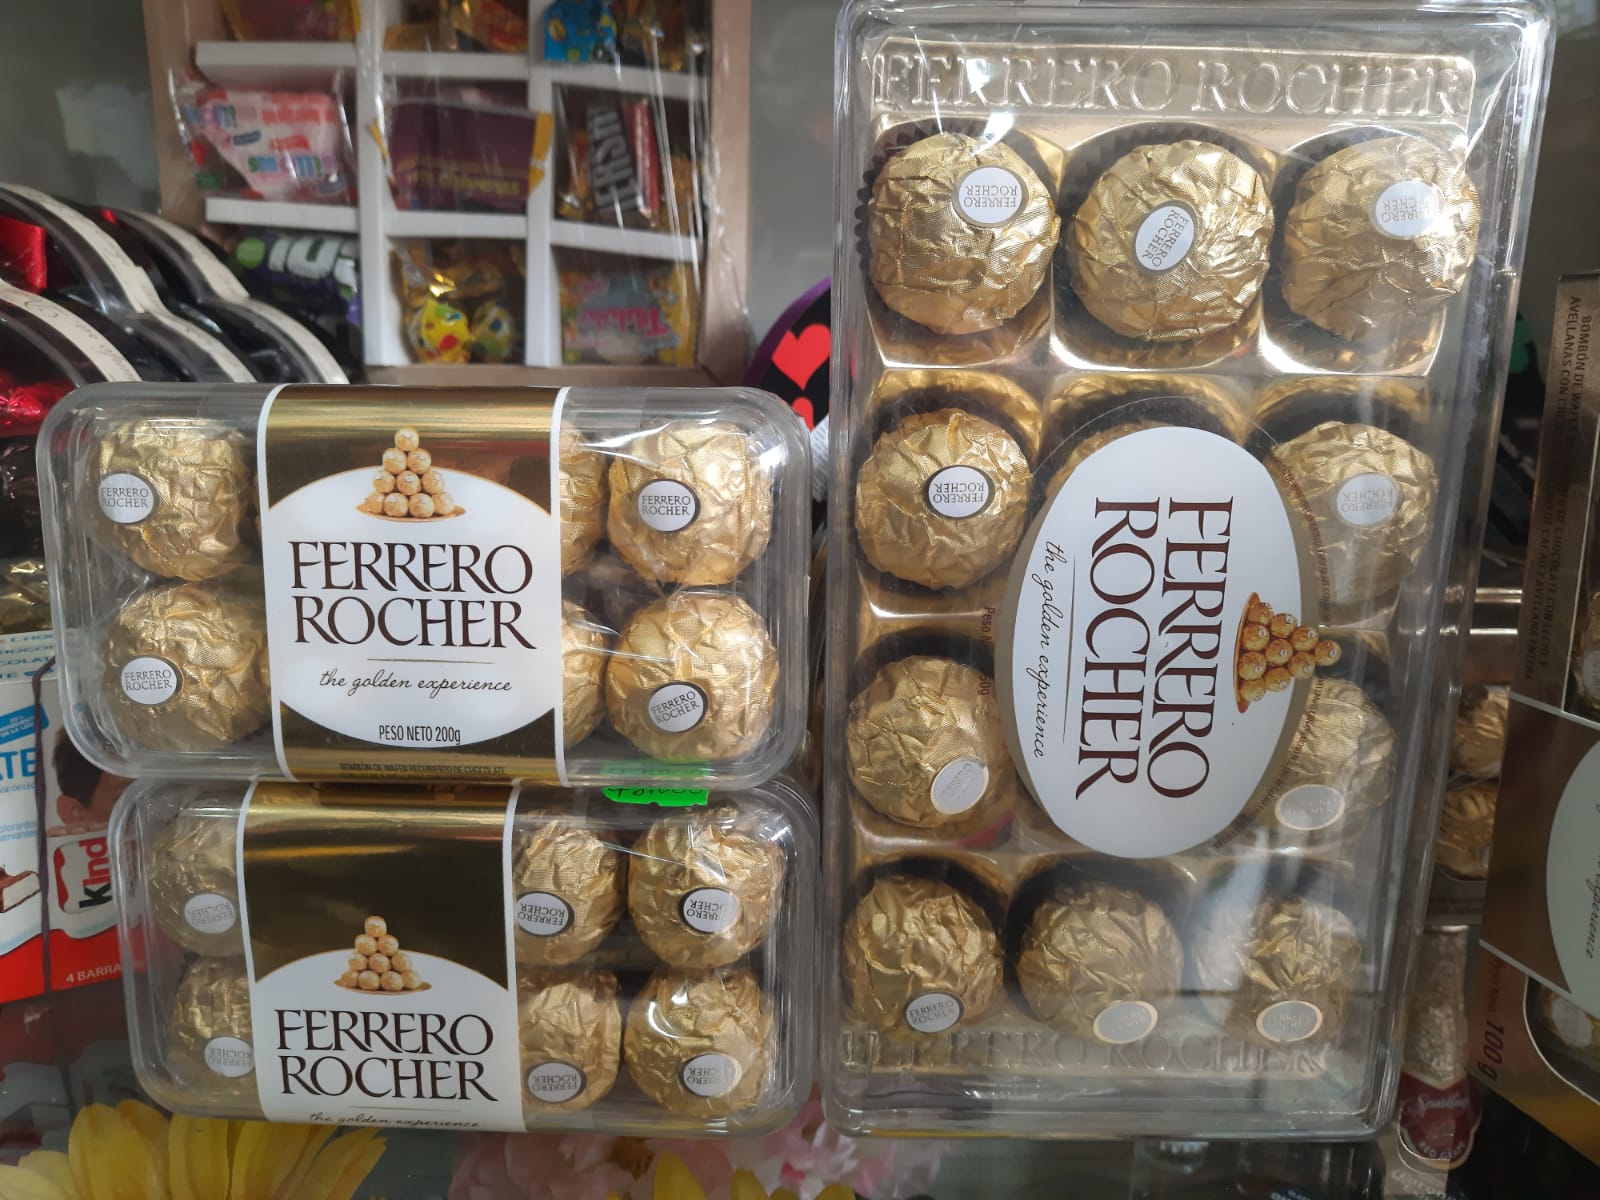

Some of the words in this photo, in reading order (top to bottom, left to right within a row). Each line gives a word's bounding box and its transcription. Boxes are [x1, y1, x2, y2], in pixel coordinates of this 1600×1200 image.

[1191, 59, 1461, 117] ROCHER
[963, 196, 1017, 208] FERRERO
[965, 184, 1017, 197] ROCHER
[1141, 209, 1180, 259] ROCHER
[1151, 215, 1189, 267] FERRERO
[933, 492, 985, 504] FERRERO
[934, 481, 985, 494] ROCHER
[641, 505, 691, 516] ROCHER
[642, 495, 691, 506] FERRERO
[287, 540, 533, 595] FERRERO
[1043, 540, 1067, 570] the
[290, 595, 537, 650] ROCHER
[981, 606, 996, 633] Peso
[1031, 572, 1066, 651] golden
[1075, 496, 1161, 801] ROCHER
[1147, 495, 1234, 799] FERRERO
[123, 668, 173, 682] FERRERO
[125, 679, 174, 692] ROCHER
[319, 668, 347, 689] the
[351, 669, 411, 698] golden
[417, 676, 513, 703] experience
[650, 690, 696, 715] FERRERO
[655, 700, 700, 724] ROCHER
[1025, 653, 1051, 759] experience
[378, 724, 405, 741] PESO
[406, 725, 433, 742] NETO
[435, 726, 461, 746] 200g
[517, 911, 564, 926] FERRERO
[520, 902, 565, 918] ROCHER
[66, 972, 75, 985] 4
[274, 1008, 494, 1056] FERRERO
[1482, 1019, 1505, 1065] 100
[278, 1054, 499, 1102] ROCHER
[532, 1073, 578, 1084] ROCHER
[532, 1082, 578, 1093] FERRERO
